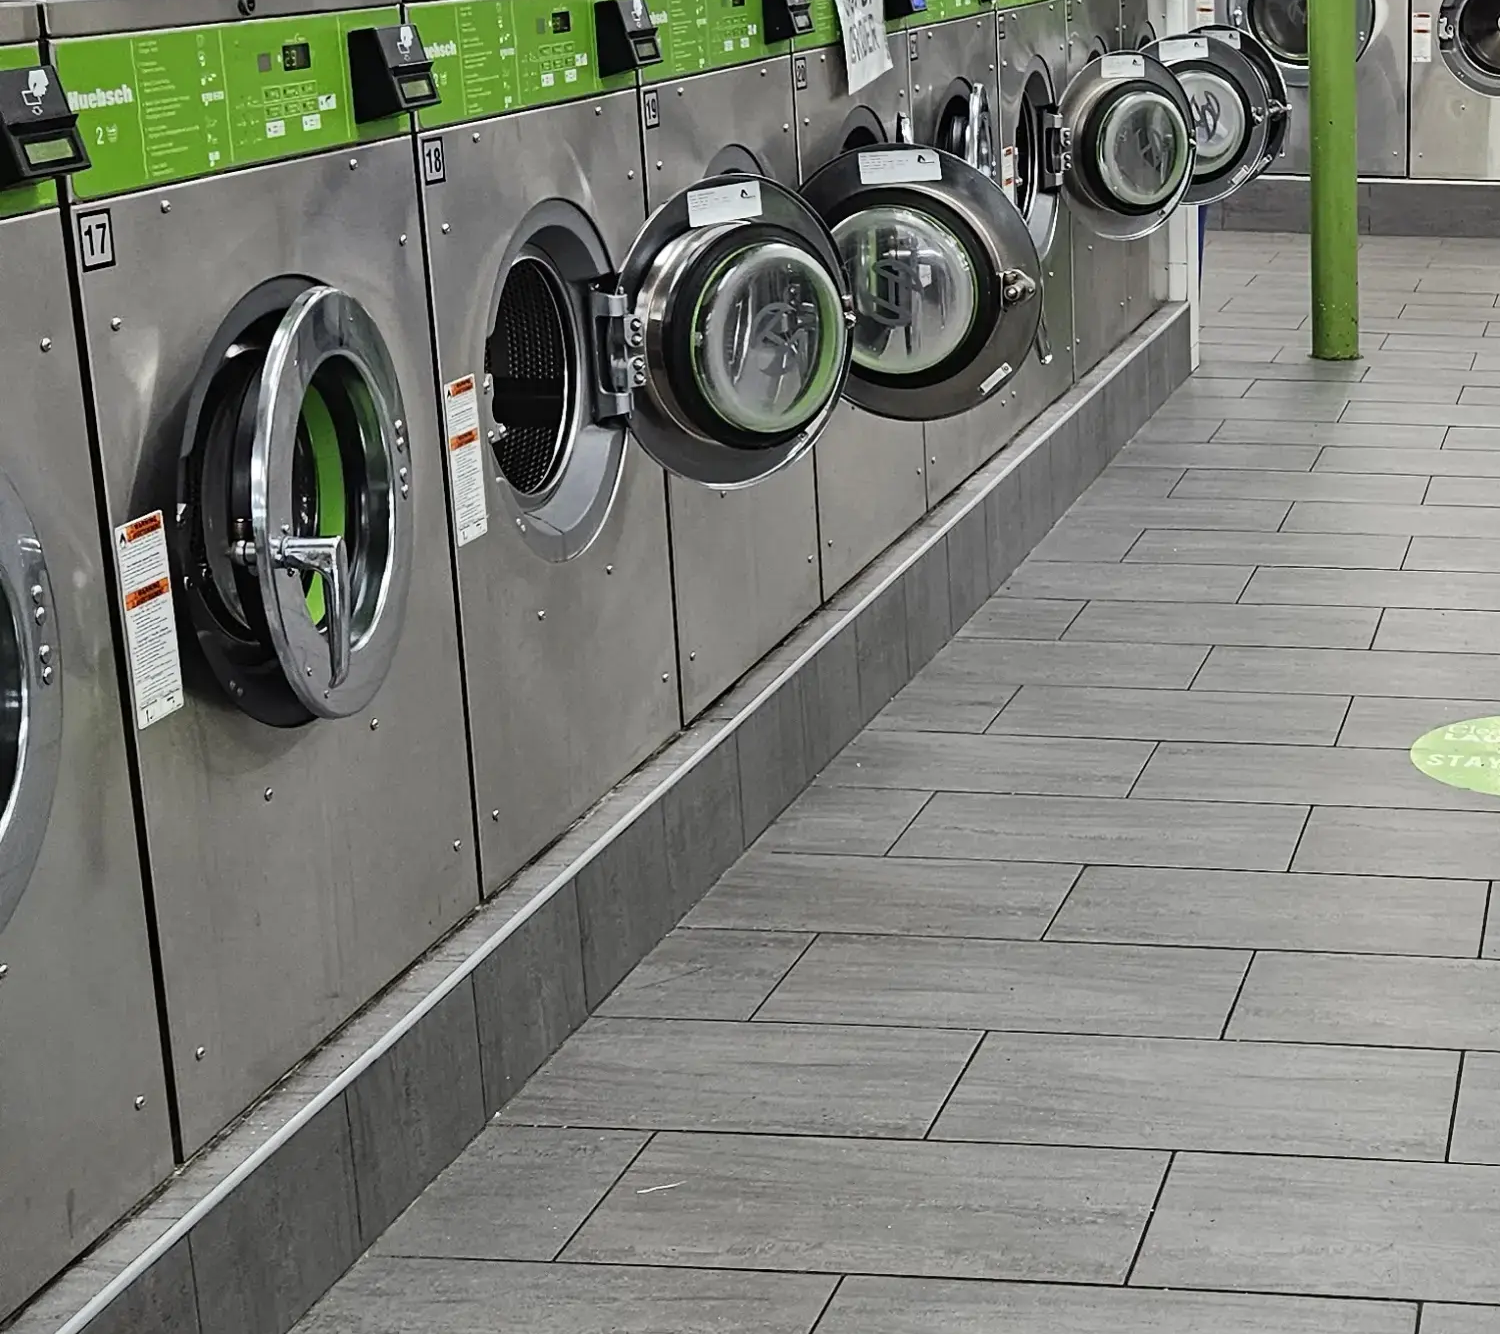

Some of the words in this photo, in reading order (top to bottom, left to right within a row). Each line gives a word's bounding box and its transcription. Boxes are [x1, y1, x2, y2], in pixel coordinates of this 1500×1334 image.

[67, 83, 134, 113] Huebsch
[646, 98, 657, 120] 19
[95, 126, 104, 145] 2
[426, 147, 442, 173] 18
[84, 223, 106, 256] 17
